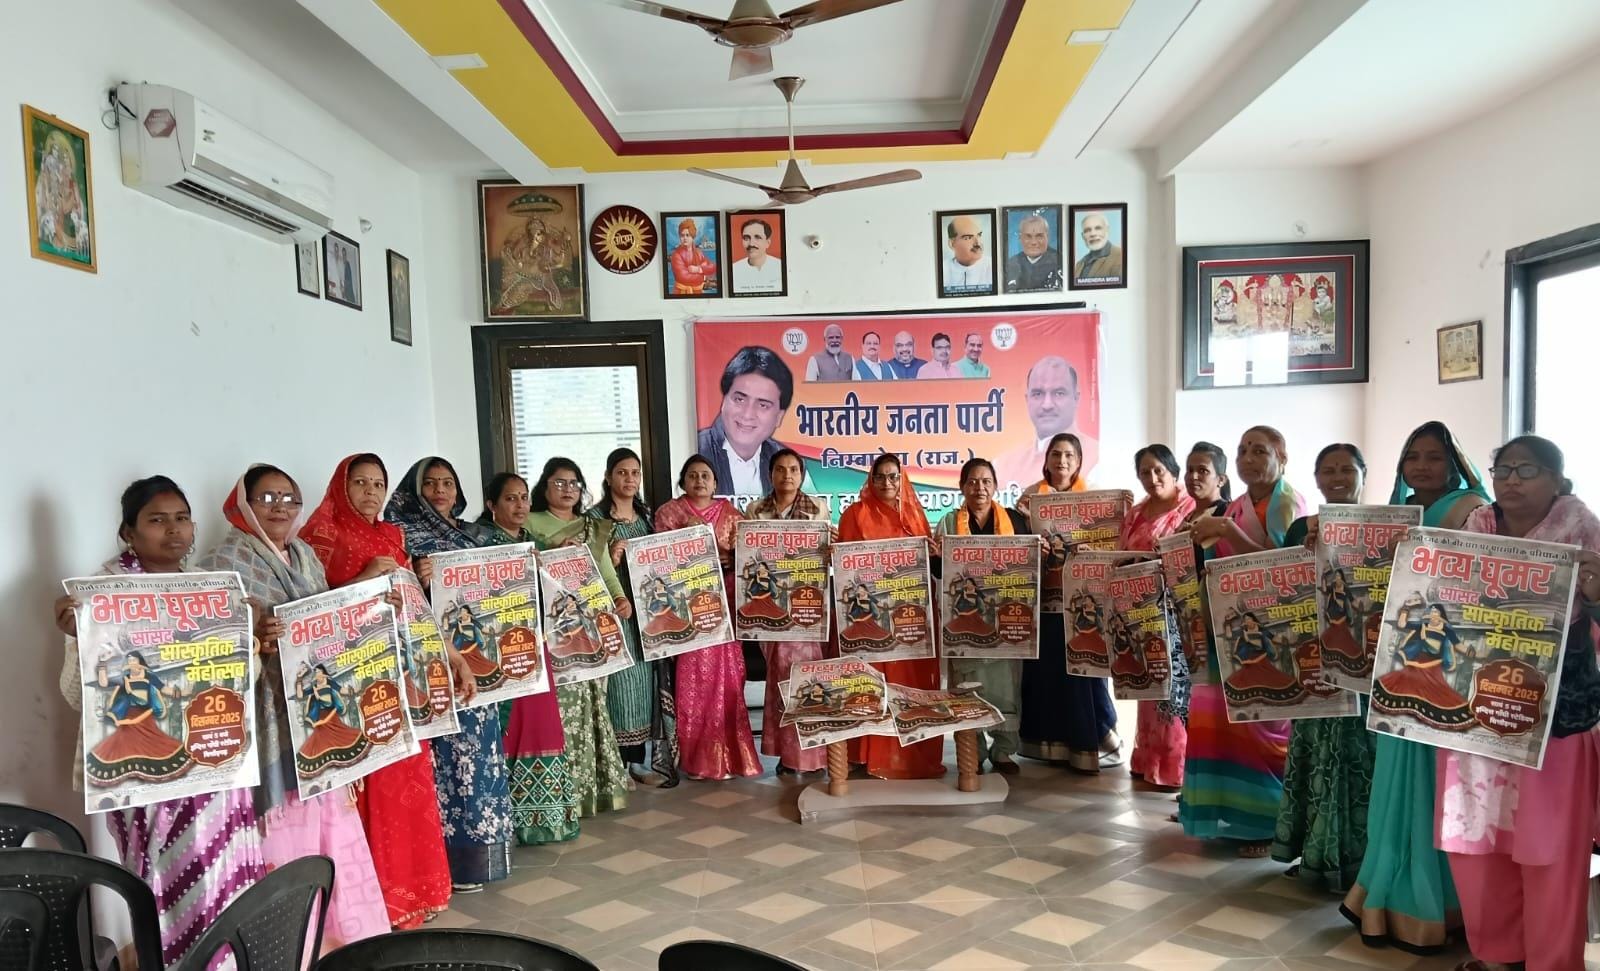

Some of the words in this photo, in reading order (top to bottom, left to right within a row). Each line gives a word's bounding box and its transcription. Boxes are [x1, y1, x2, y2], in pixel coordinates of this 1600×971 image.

[796, 391, 880, 436] भारतीय
[886, 404, 949, 434] जनता
[956, 388, 1005, 433] पार्टी
[1039, 504, 1072, 520] भव्य
[1076, 502, 1116, 524] घूमर
[745, 532, 780, 549] भव्य
[782, 531, 820, 554] घूमर
[1324, 522, 1361, 547] भव्य
[636, 544, 668, 566] भव्य
[672, 538, 706, 563] घूमर
[842, 552, 876, 570] भव्य
[879, 550, 918, 573] घूमर
[952, 548, 988, 564] भव्य
[990, 548, 1029, 570] घूमर
[442, 564, 482, 588] भव्य
[484, 558, 526, 588] घूमर
[670, 563, 711, 581] सांस्कृतिक
[776, 557, 820, 573] सांस्कृतिक
[789, 569, 826, 582] महोत्सव
[1072, 563, 1106, 580] भव्य
[1411, 546, 1475, 583] भव्य
[1480, 554, 1556, 599] घूमर
[686, 576, 720, 590] महोत्सव
[875, 576, 920, 590] सांस्कृतिक
[984, 574, 1029, 588] सांस्कृतिक
[1220, 568, 1265, 594] भव्य
[480, 592, 529, 614] सांस्कृतिक
[698, 594, 711, 605] 26
[800, 588, 814, 599] 26
[1438, 585, 1481, 606] सांसद
[92, 592, 158, 624] भव्य
[160, 589, 232, 631] घूमर
[496, 606, 534, 624] महोत्सव
[902, 606, 916, 618] 26
[1008, 605, 1022, 616] 26
[1462, 602, 1546, 634] सांस्कृतिक
[290, 610, 336, 647] भव्य
[337, 596, 382, 640] घूमर
[130, 628, 174, 646] सांसद
[510, 630, 525, 644] 26
[1151, 640, 1161, 652] 26
[1485, 630, 1556, 658] महोत्सव
[158, 636, 235, 666] सांस्कृतिक
[315, 640, 346, 661] सांसद
[335, 638, 387, 666] सांस्कृतिक
[186, 660, 246, 682] महोत्सव
[354, 654, 396, 680] महोत्सव
[1498, 665, 1524, 686] 26
[370, 684, 387, 703] 26
[855, 696, 870, 704] 26
[1480, 678, 1514, 696] दिसम्बर
[1515, 688, 1539, 701] 2025
[204, 694, 226, 714] 26
[191, 714, 220, 728] दिसम्बर
[220, 712, 240, 724] 2025
